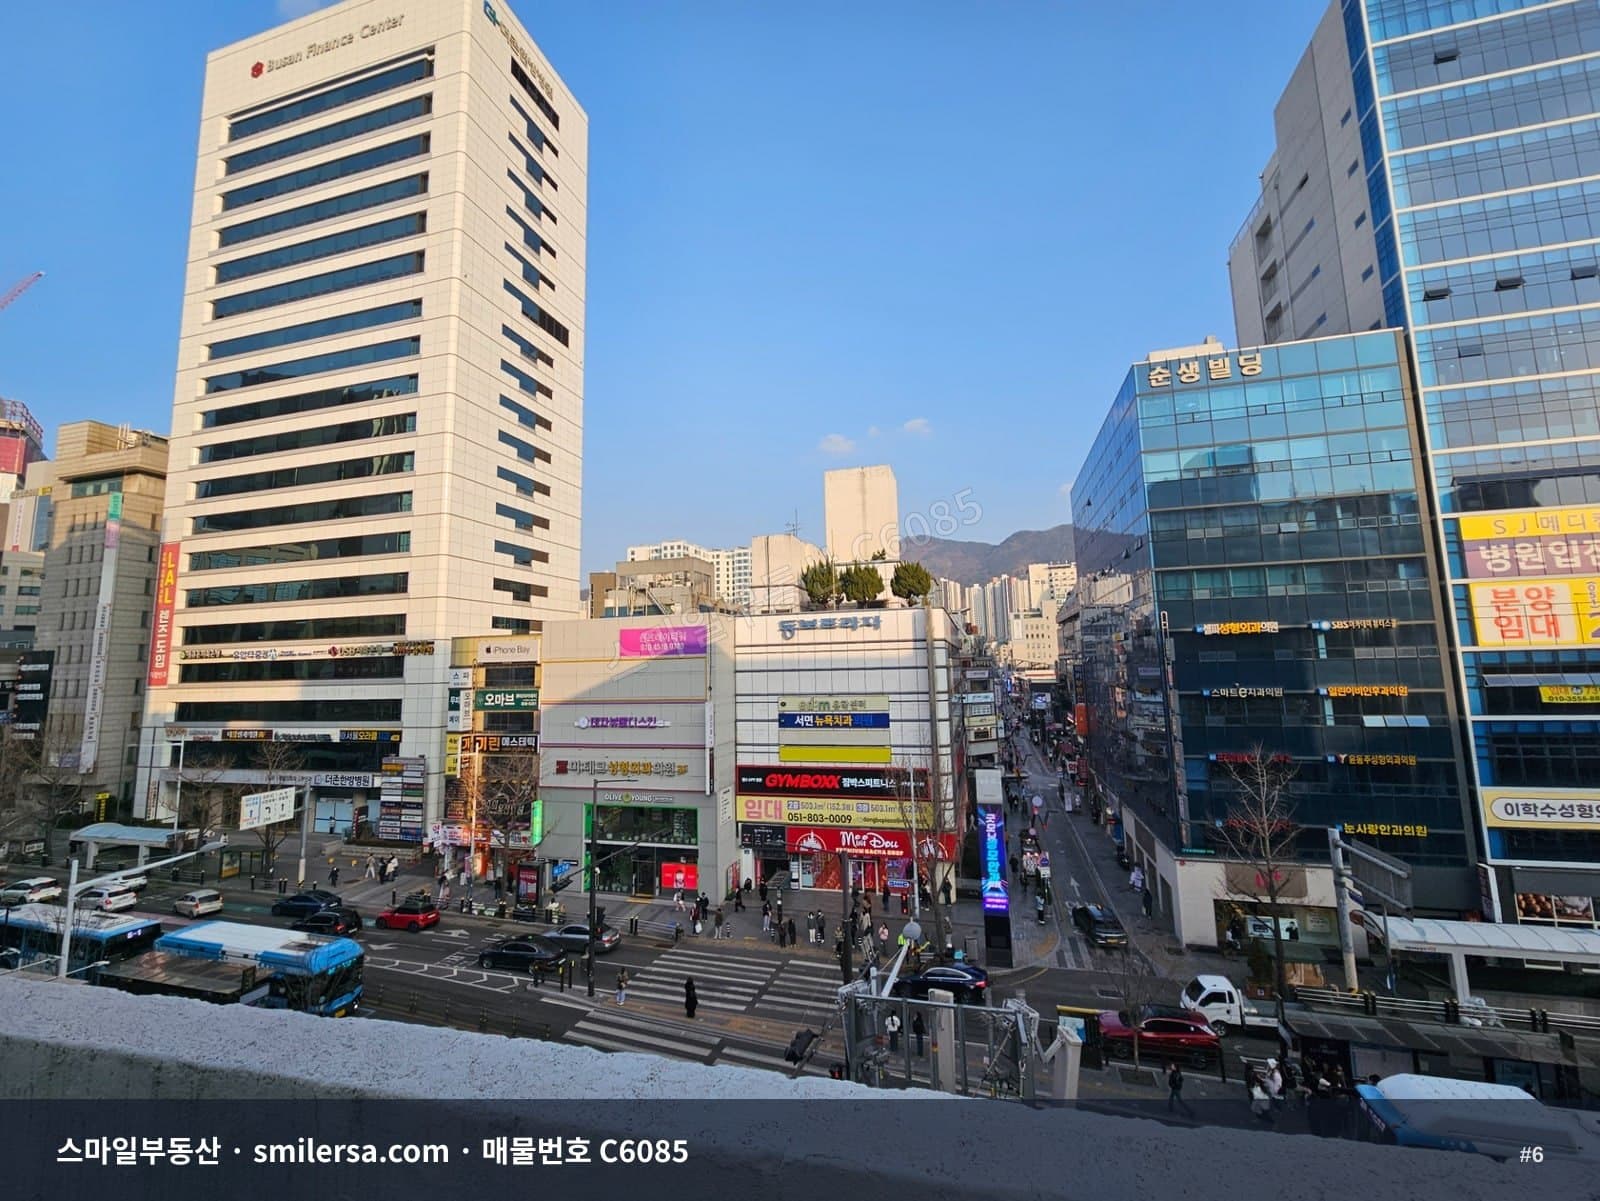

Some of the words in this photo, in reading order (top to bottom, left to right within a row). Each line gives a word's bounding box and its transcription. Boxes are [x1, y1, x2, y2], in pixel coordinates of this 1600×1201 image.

[266, 52, 303, 73] Busan
[306, 33, 354, 59] Finance
[359, 14, 405, 39] Center
[1490, 585, 1556, 612] 분양
[1493, 613, 1561, 639] 임대
[493, 645, 516, 655] iPhone
[517, 645, 531, 656] Bay
[484, 693, 516, 707] 오마브
[794, 714, 814, 727] 서면
[501, 737, 536, 747] 에스테틱
[765, 773, 841, 789] GYMBOXX
[604, 793, 623, 801] OLIVE
[631, 793, 652, 802] YOUNG
[744, 799, 783, 820] 임대
[787, 812, 853, 824] 051-803-0009
